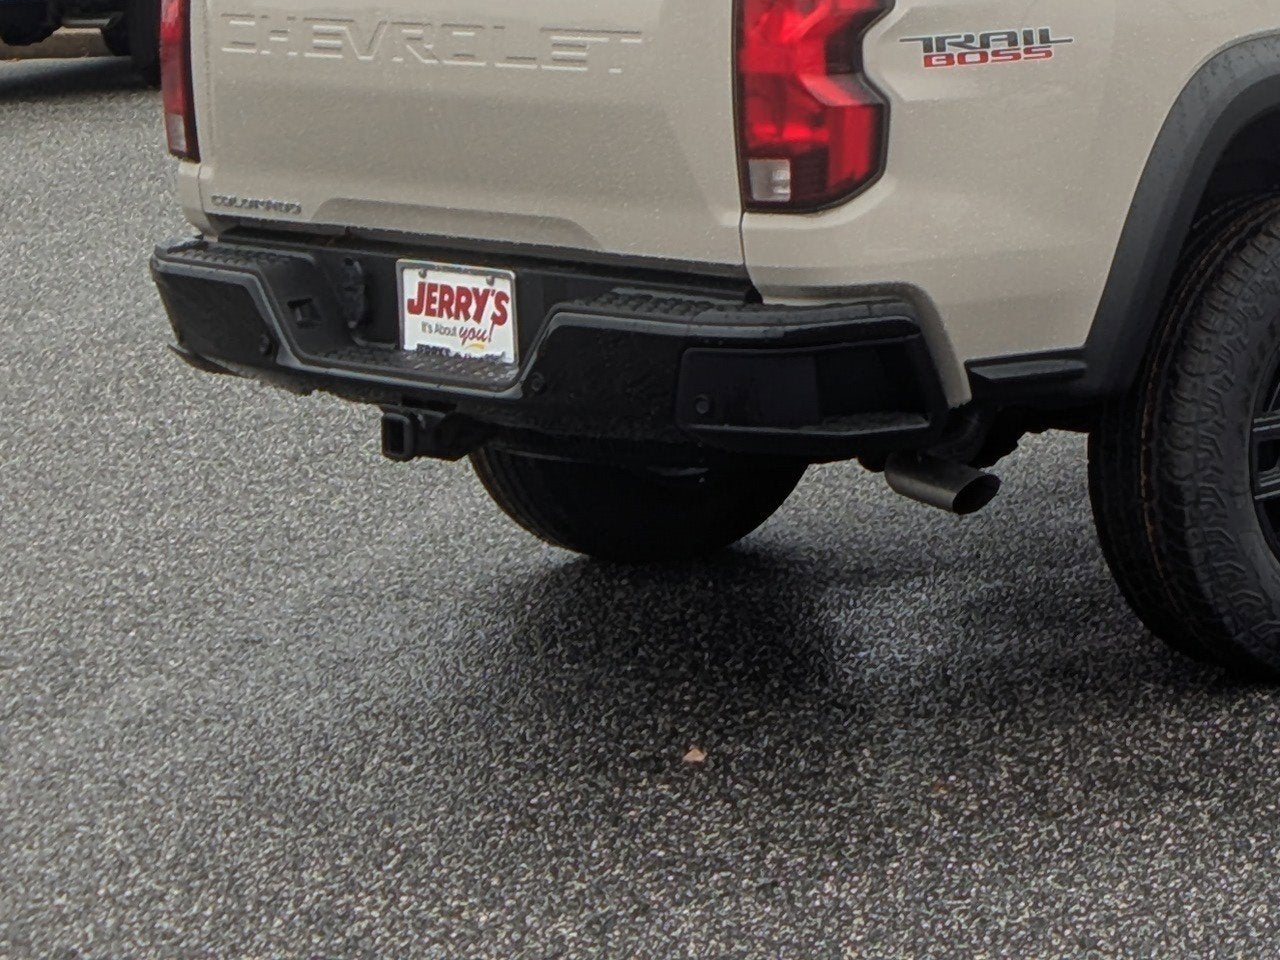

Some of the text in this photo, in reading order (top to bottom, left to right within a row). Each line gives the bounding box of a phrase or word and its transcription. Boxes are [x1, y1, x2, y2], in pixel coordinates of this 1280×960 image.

[220, 12, 643, 74] CHEVROLET
[899, 27, 1074, 54] TRAIL
[923, 44, 1053, 68] BOSS
[406, 280, 509, 327] JERRY'S
